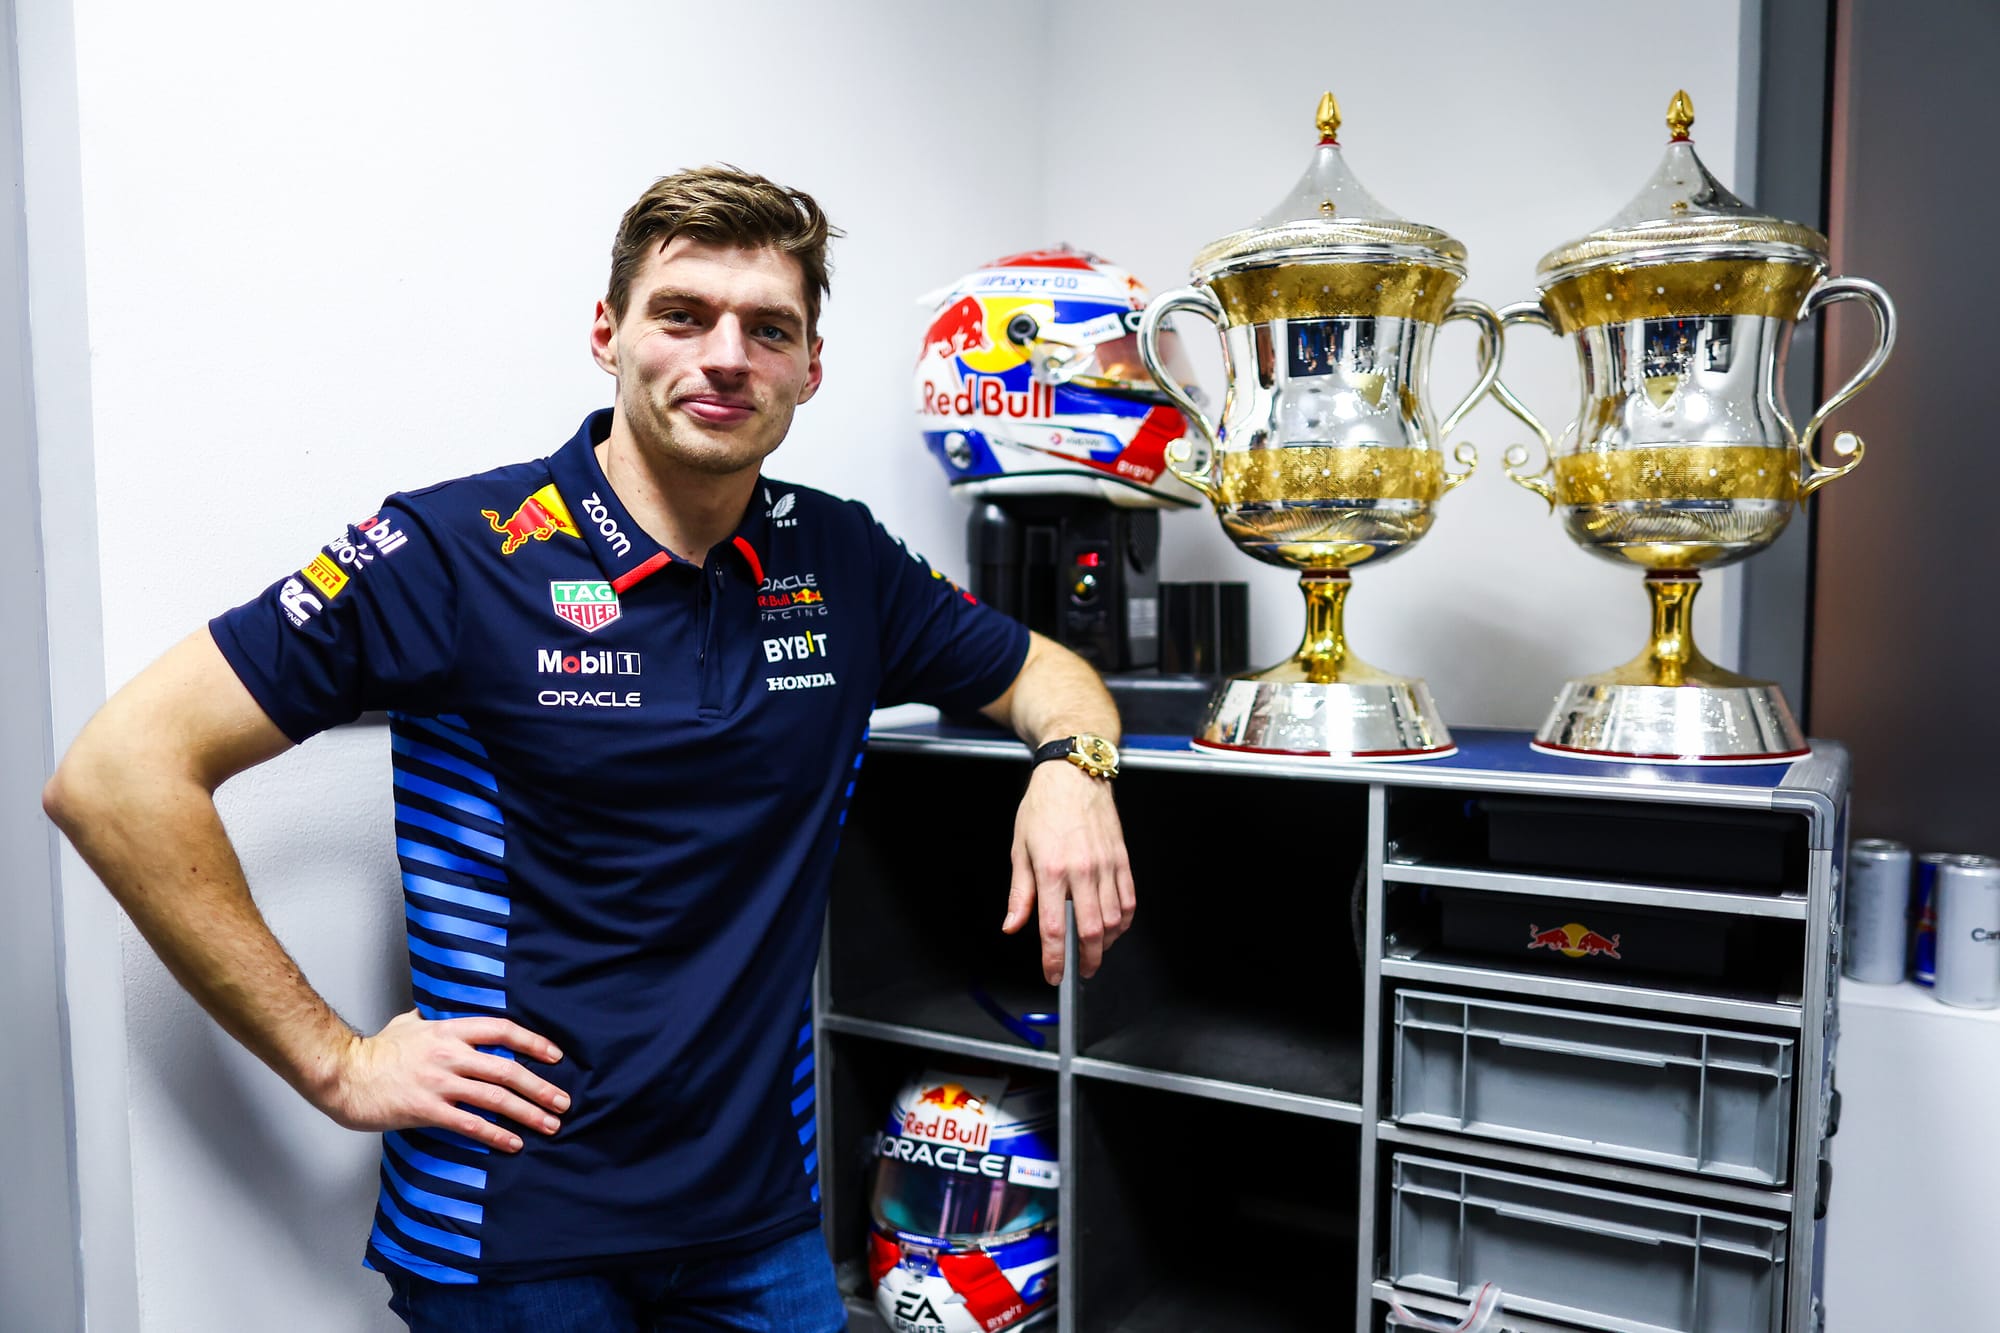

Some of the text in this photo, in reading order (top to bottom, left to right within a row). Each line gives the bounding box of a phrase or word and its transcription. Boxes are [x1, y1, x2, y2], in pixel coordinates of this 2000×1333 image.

[923, 379, 1053, 418] Red Bull
[350, 512, 409, 555] obil
[581, 492, 632, 558] zoom
[557, 584, 613, 601] TAG
[557, 604, 617, 628] HEUER
[538, 650, 612, 674] Mobil
[763, 631, 828, 663] BYBIT
[538, 690, 641, 707] ORACLE
[766, 673, 836, 691] HONDA
[903, 1112, 988, 1147] Red Bull
[881, 1135, 1006, 1178] ORACLE
[894, 1290, 942, 1324] EA
